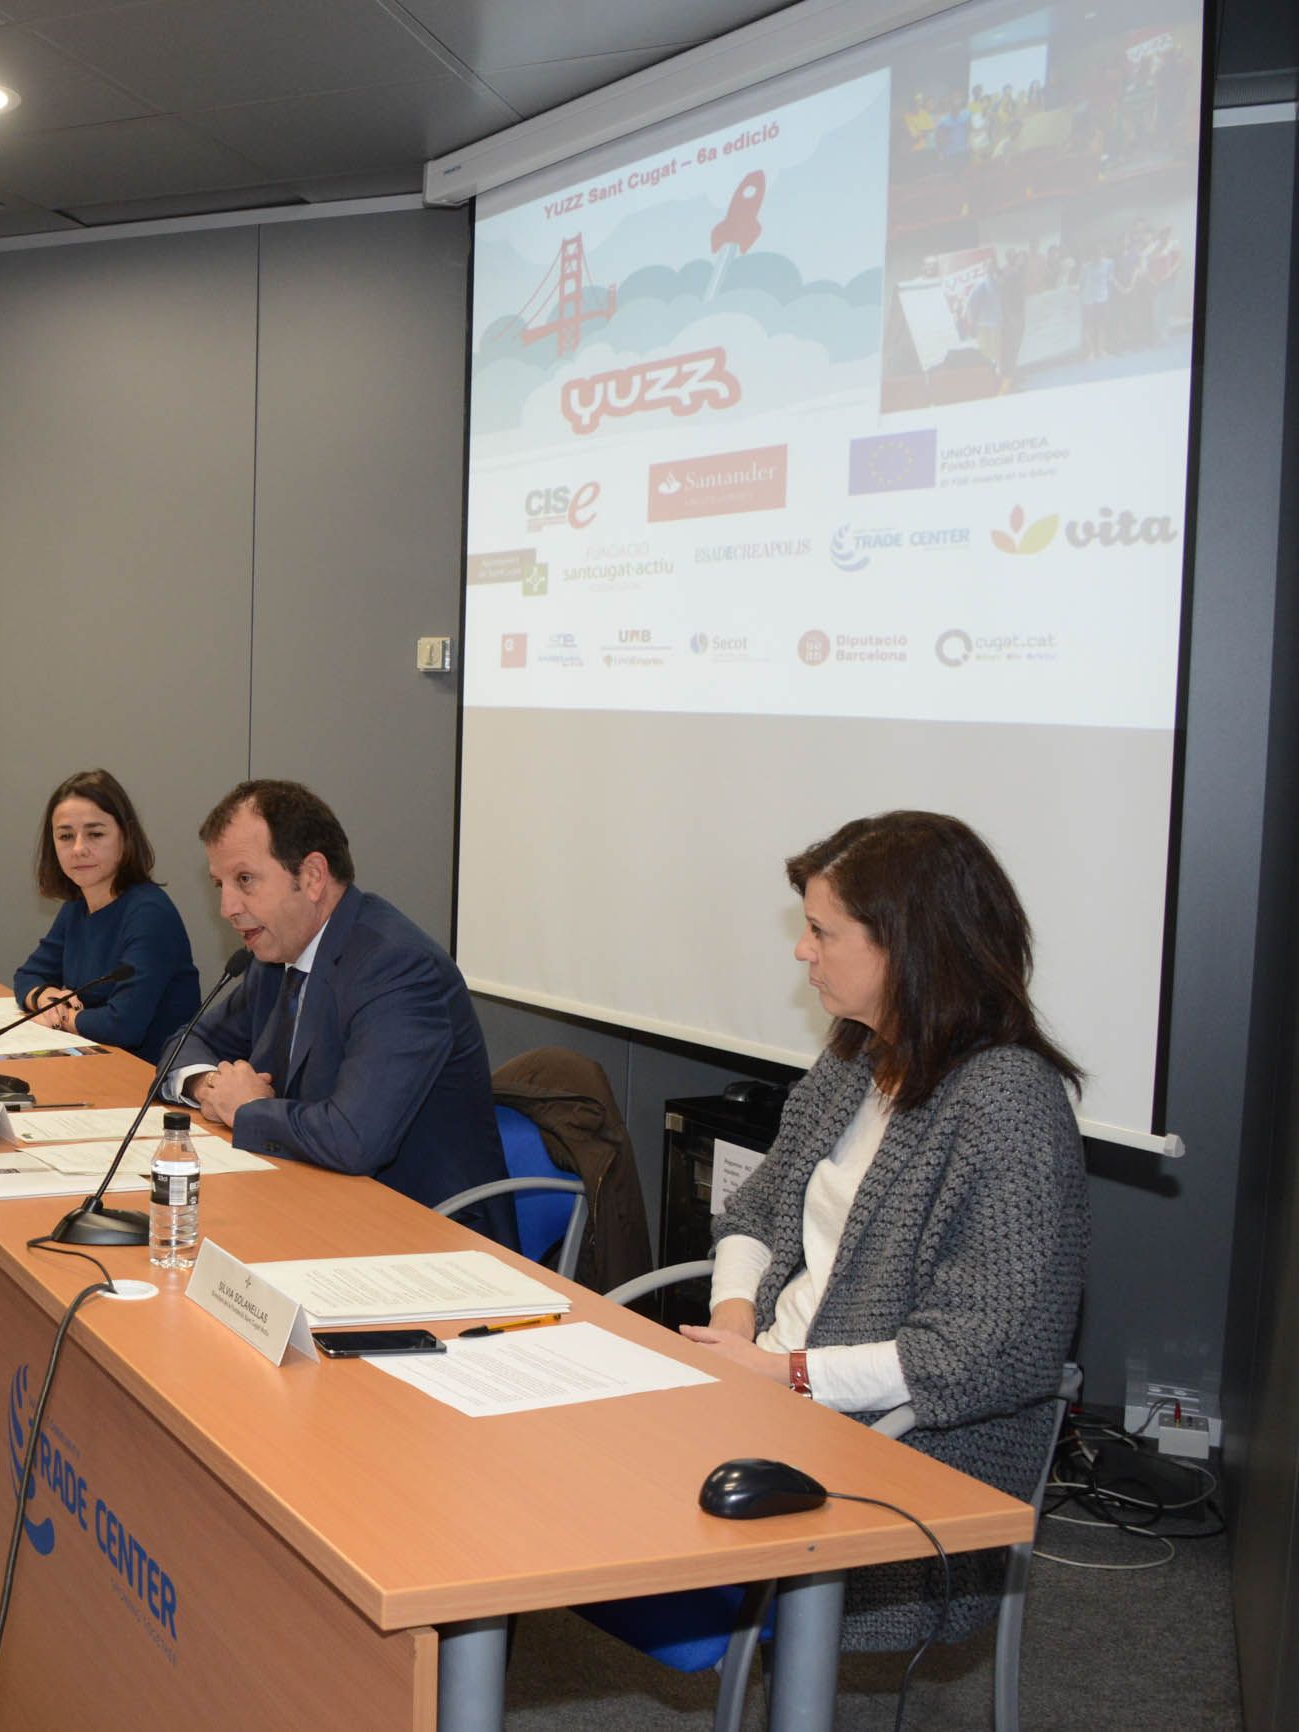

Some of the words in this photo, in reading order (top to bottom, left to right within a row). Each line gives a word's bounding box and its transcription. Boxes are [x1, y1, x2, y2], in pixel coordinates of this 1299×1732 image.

[544, 193, 584, 219] YUZZ
[588, 178, 623, 205] Sant
[628, 160, 678, 190] Cugat
[697, 145, 718, 165] 6a
[723, 121, 780, 156] edició
[684, 461, 778, 492] Santander
[853, 532, 903, 550] TRADE
[909, 527, 971, 547] CENTER
[1065, 506, 1178, 549] vita
[835, 648, 907, 662] Barcelona
[95, 1498, 178, 1641] CENTER
